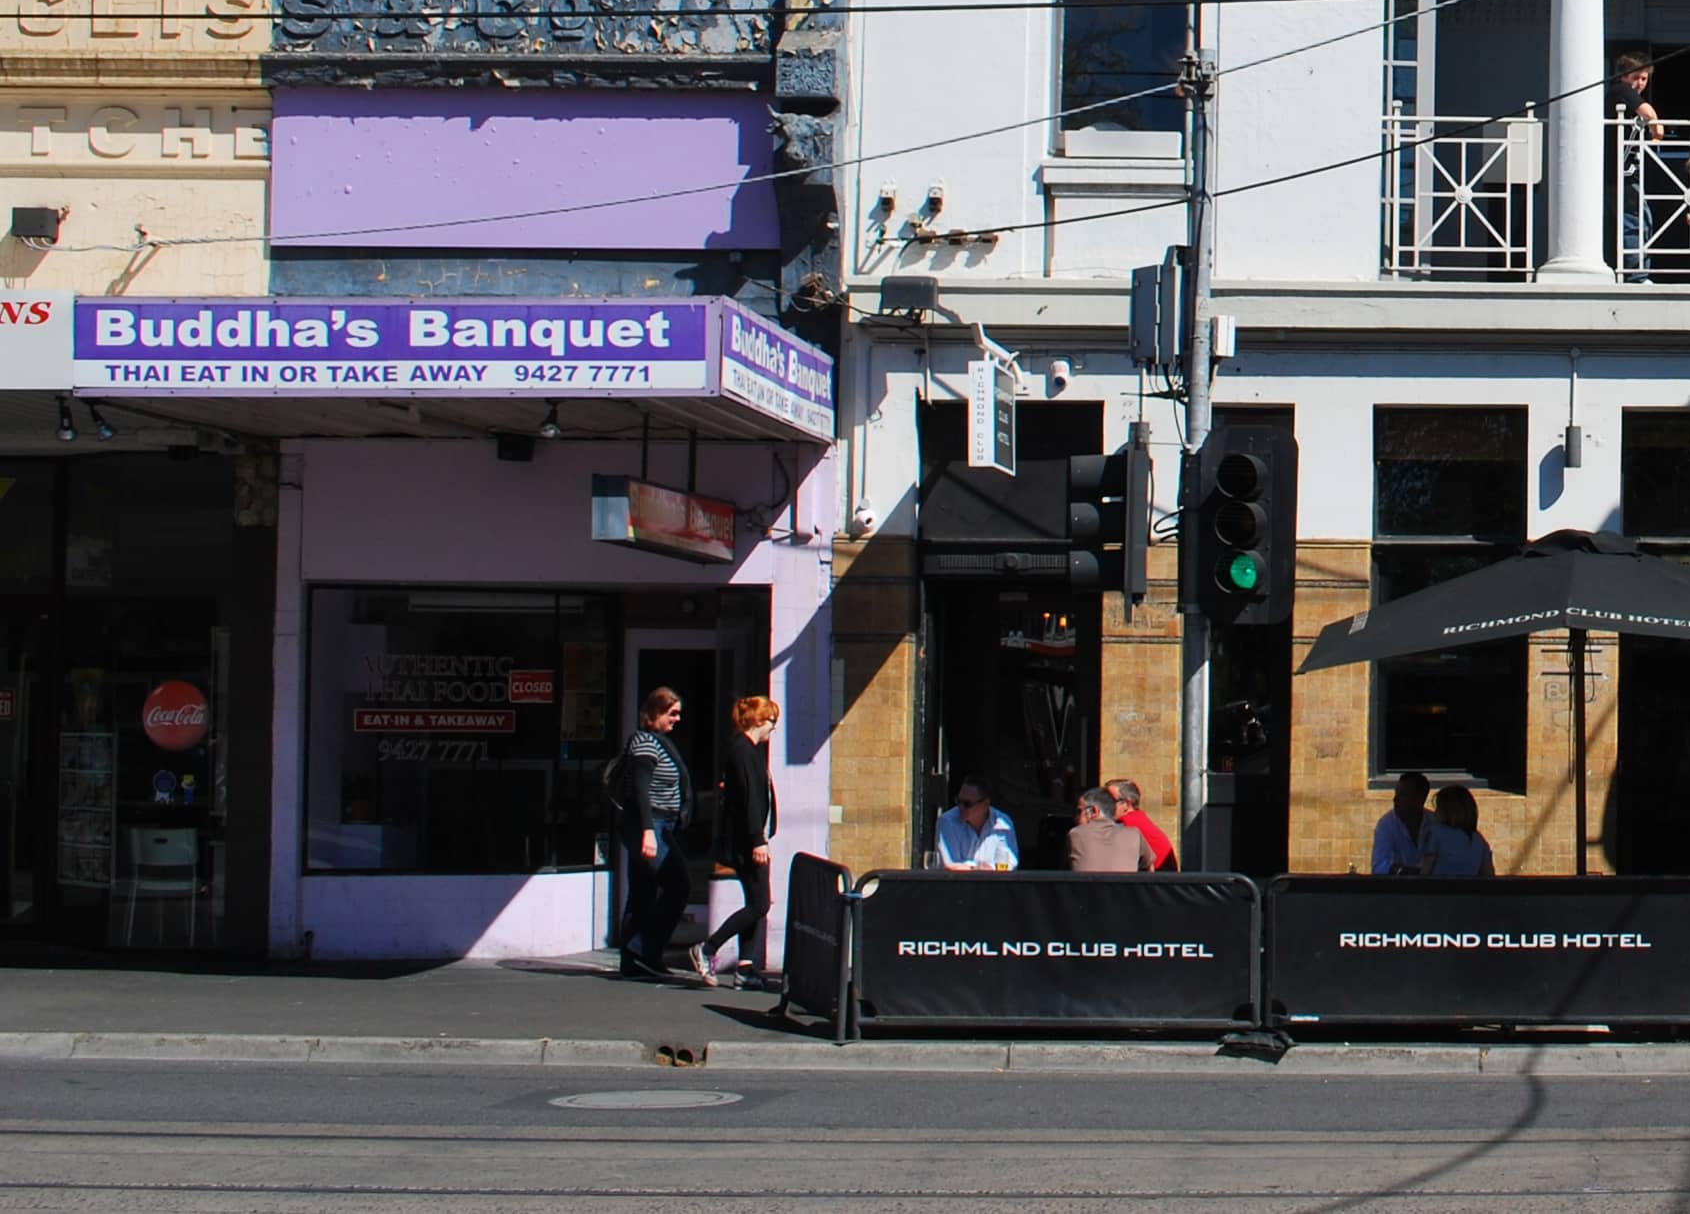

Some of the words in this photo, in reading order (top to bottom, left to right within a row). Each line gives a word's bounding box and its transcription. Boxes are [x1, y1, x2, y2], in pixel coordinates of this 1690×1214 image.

[96, 309, 379, 348] Buddha's
[409, 309, 670, 357] Banquet
[731, 314, 785, 379] Buddha's
[788, 349, 832, 402] Banquet
[105, 365, 169, 382] THAI
[181, 365, 231, 382] EAT
[242, 365, 268, 382] IN
[279, 365, 317, 383] OR
[327, 365, 399, 382] TAKE
[409, 365, 488, 382] AWAY
[514, 365, 578, 382] 9427
[588, 365, 650, 382] 7771
[1442, 609, 1560, 635] RICHMOND
[1565, 607, 1623, 621] CLUB
[433, 680, 508, 703] FOOD
[511, 681, 553, 693] CLOSED
[414, 714, 425, 726] &
[429, 714, 505, 727] TAKEAWAY
[378, 738, 433, 762] 9427
[438, 739, 490, 762] 7771
[1048, 942, 1117, 957] CLUB
[1339, 933, 1481, 948] RICHMOND
[1487, 933, 1556, 948] CLUB
[1562, 934, 1652, 948] HOTEL
